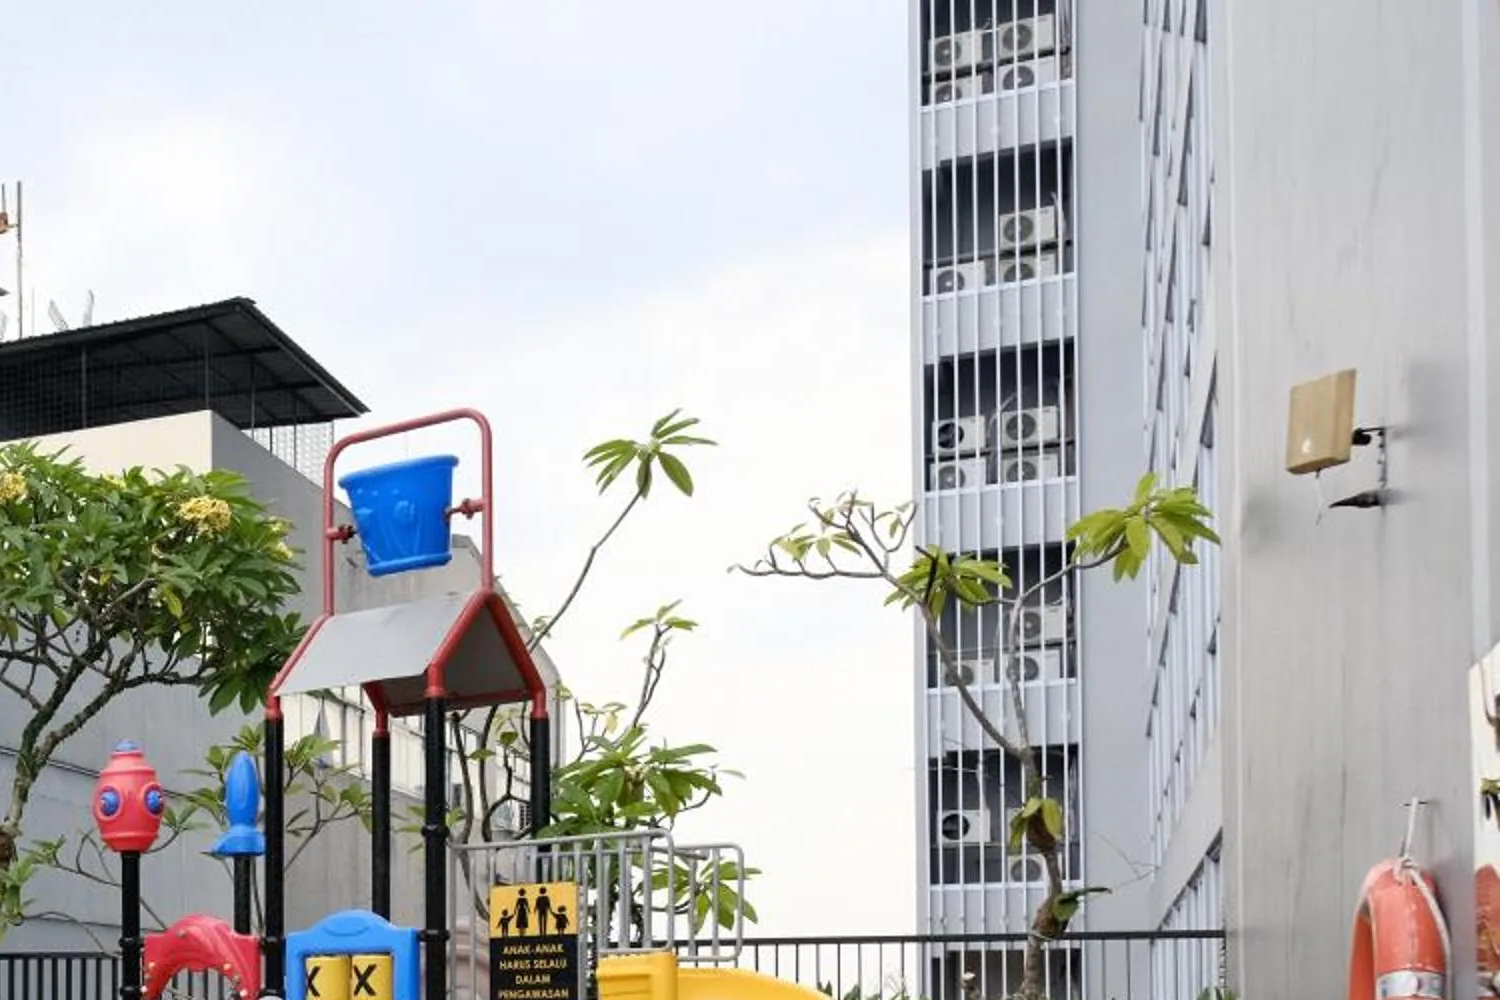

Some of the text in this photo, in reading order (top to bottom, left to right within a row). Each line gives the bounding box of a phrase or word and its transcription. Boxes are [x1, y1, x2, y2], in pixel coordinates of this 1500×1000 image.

[502, 943, 565, 955] ANAK-ANAK
[499, 957, 568, 970] HARUS SELALU
[353, 964, 377, 996] X
[515, 974, 551, 985] DALAM
